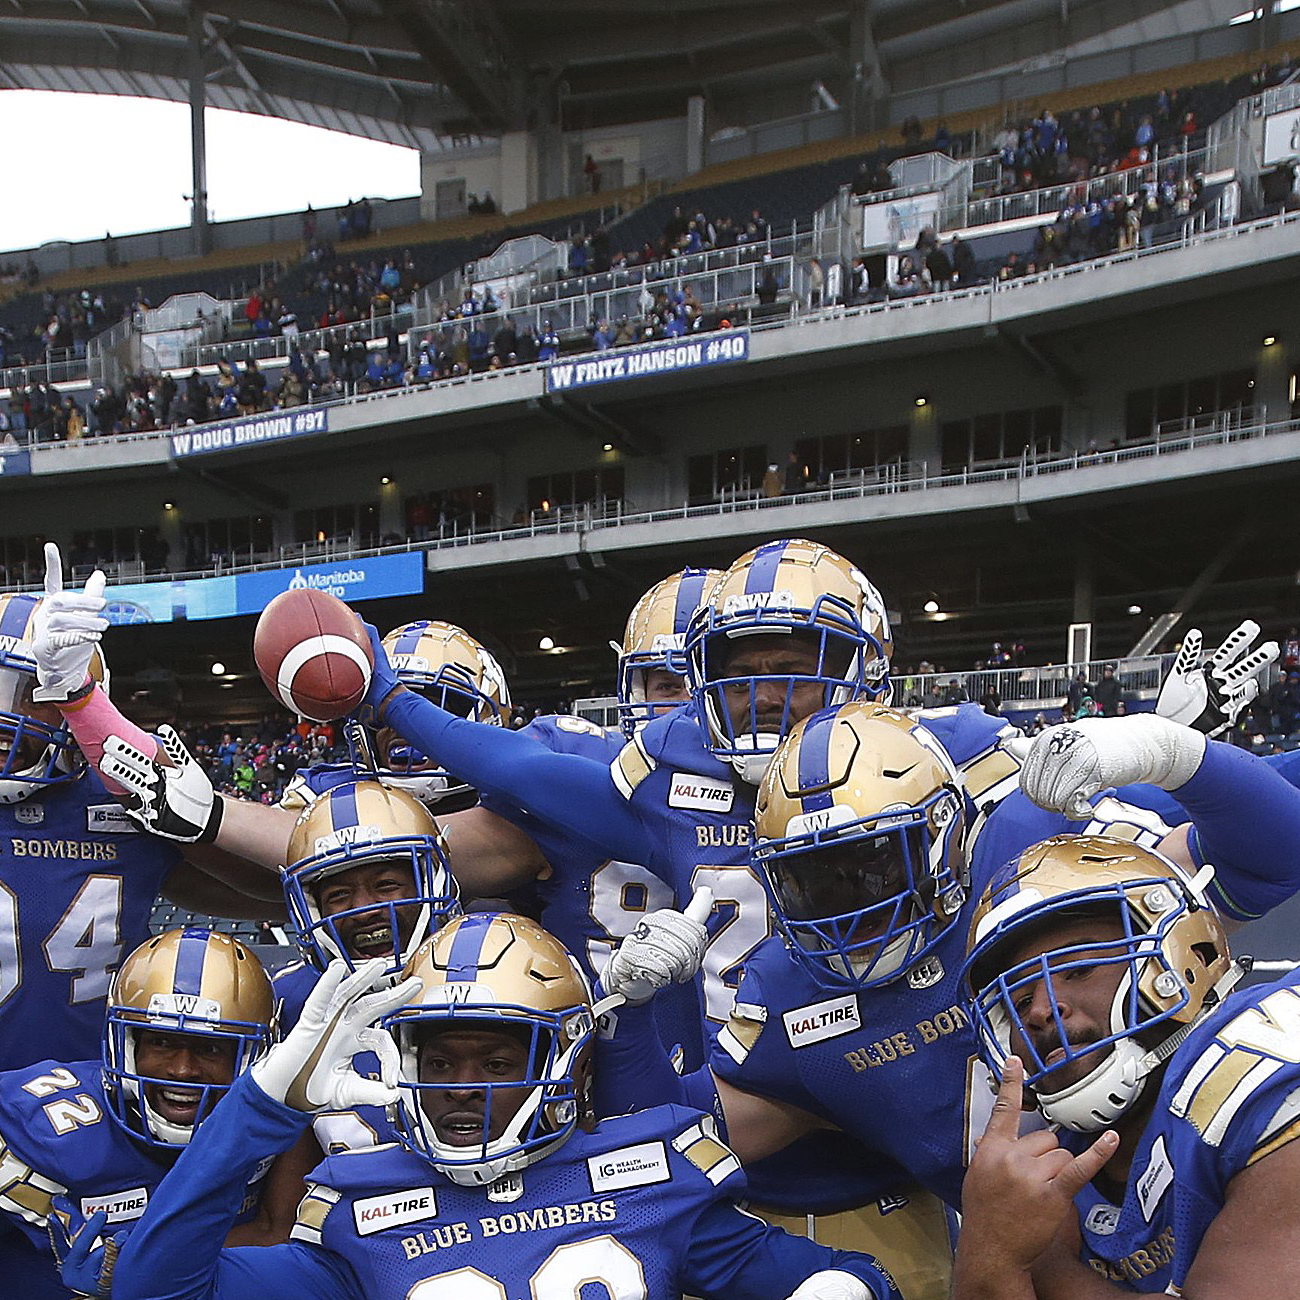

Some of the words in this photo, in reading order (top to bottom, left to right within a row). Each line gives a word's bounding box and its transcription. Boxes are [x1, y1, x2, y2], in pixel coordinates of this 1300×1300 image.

[575, 360, 626, 384] FRITZ
[628, 343, 701, 374] HANSON
[706, 336, 745, 360] #40
[192, 428, 232, 451] DOUG
[234, 416, 293, 443] BROWN
[295, 411, 325, 432] #97
[308, 569, 366, 588] Manitoba
[696, 825, 751, 847] BLUE
[12, 838, 119, 861] BOMBERS
[174, 996, 198, 1014] W
[843, 1032, 916, 1073] BLUE
[22, 1067, 103, 1136] 22
[599, 1163, 616, 1178] IG
[616, 1158, 642, 1168] WEALTH
[617, 1161, 660, 1174] MANAGEMENT
[401, 1222, 472, 1260] BLUE
[478, 1200, 618, 1238] BOMBERS
